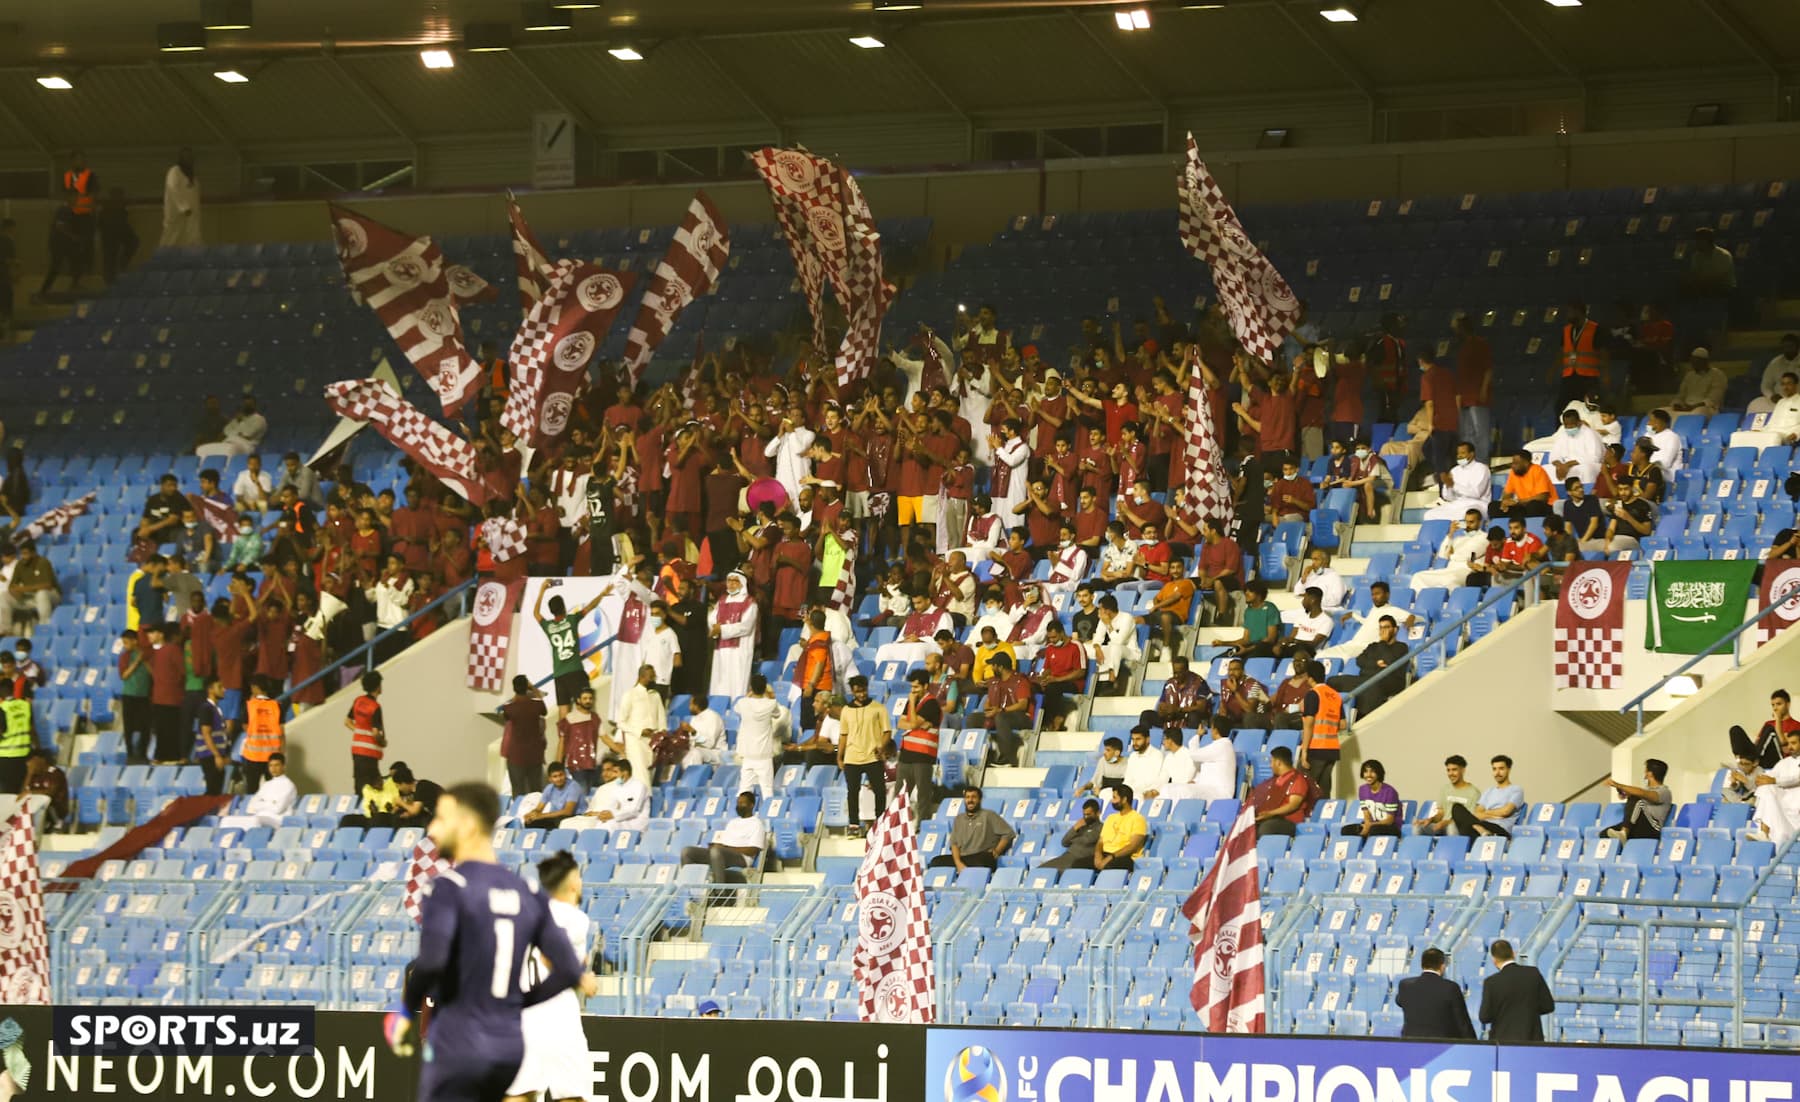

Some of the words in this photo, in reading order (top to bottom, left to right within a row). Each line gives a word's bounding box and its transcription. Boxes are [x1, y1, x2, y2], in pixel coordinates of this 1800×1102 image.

[551, 629, 576, 653] 94
[490, 917, 515, 999] 1
[46, 1039, 376, 1100] NEOM.COM
[591, 1050, 710, 1102] EOM
[1018, 1055, 1039, 1102] FC
